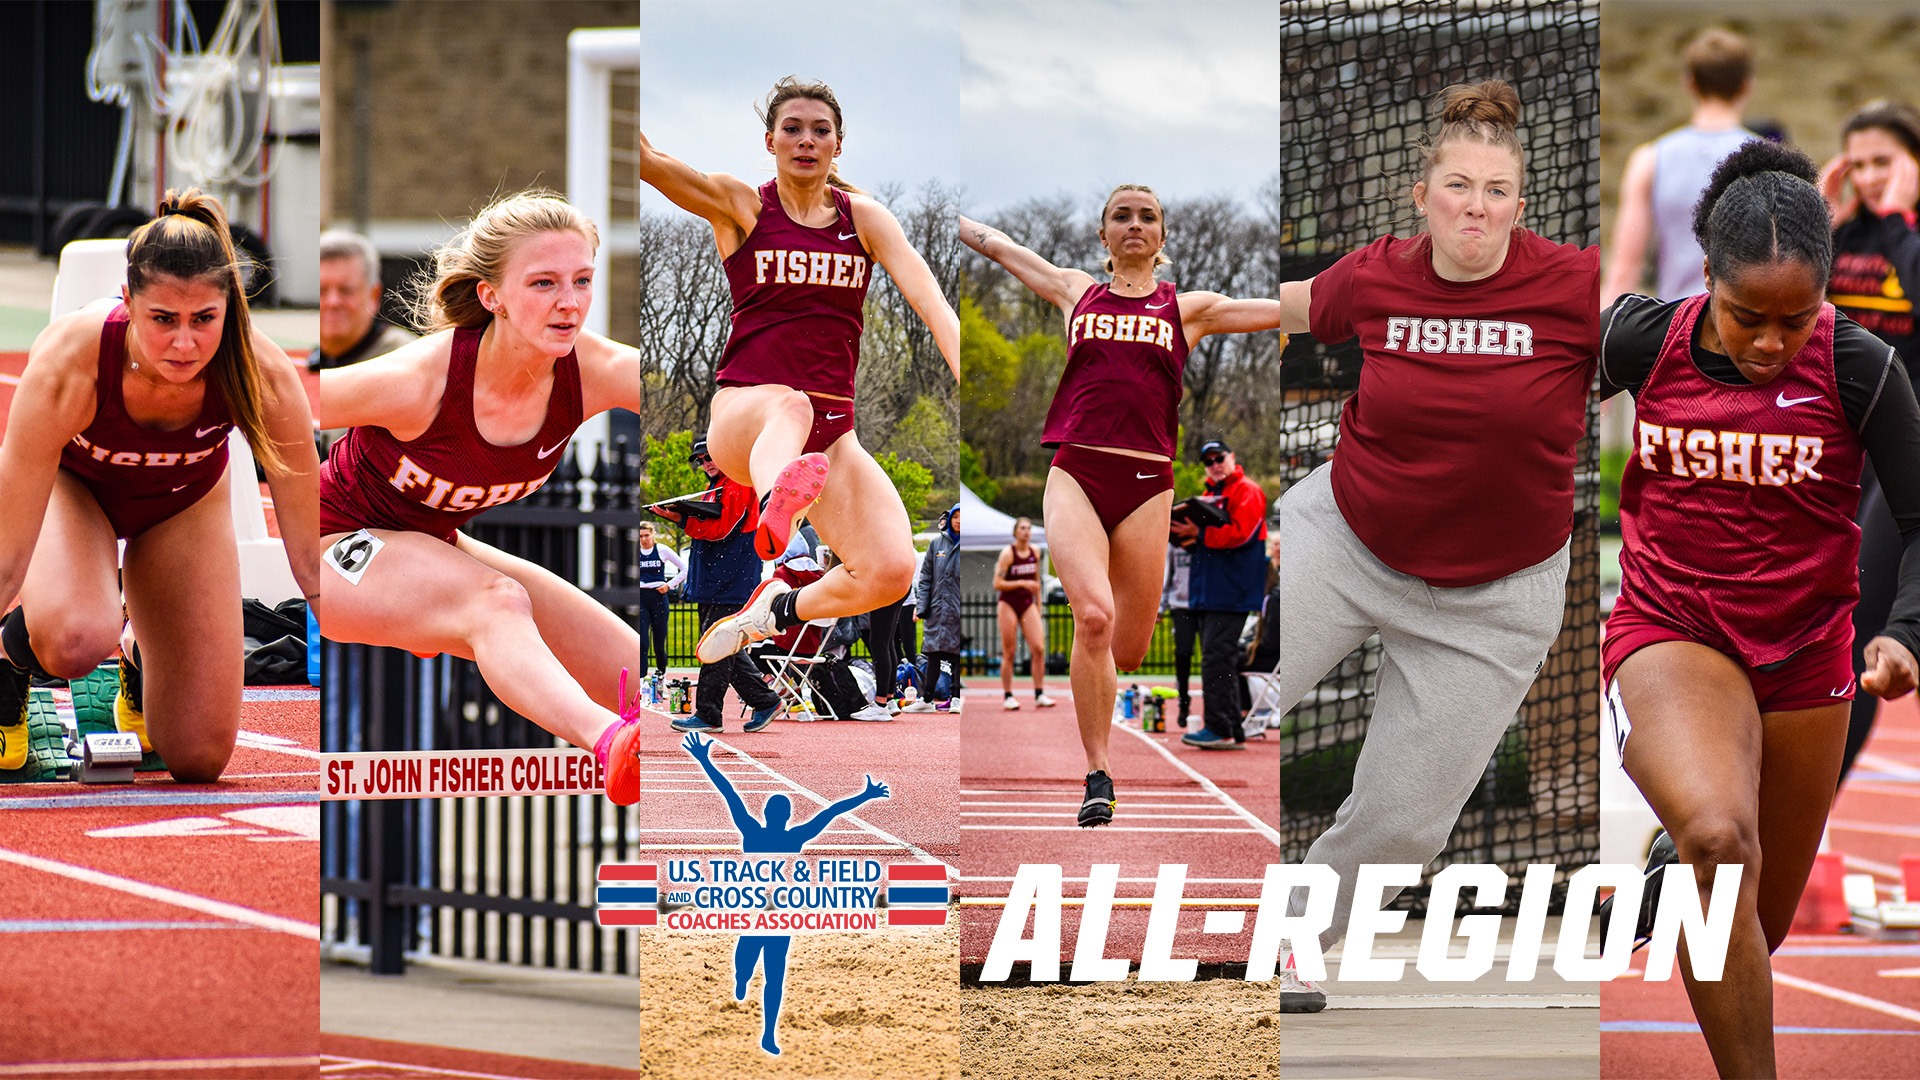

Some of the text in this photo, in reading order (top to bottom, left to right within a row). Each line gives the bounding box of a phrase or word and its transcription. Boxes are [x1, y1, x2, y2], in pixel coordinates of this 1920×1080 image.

[755, 250, 867, 288] FISHER
[1071, 313, 1174, 352] FISHER
[1384, 317, 1533, 356] FISHER
[1639, 420, 1825, 487] FISHER
[327, 754, 606, 795] ST. JOHN FISHER COLLEGE
